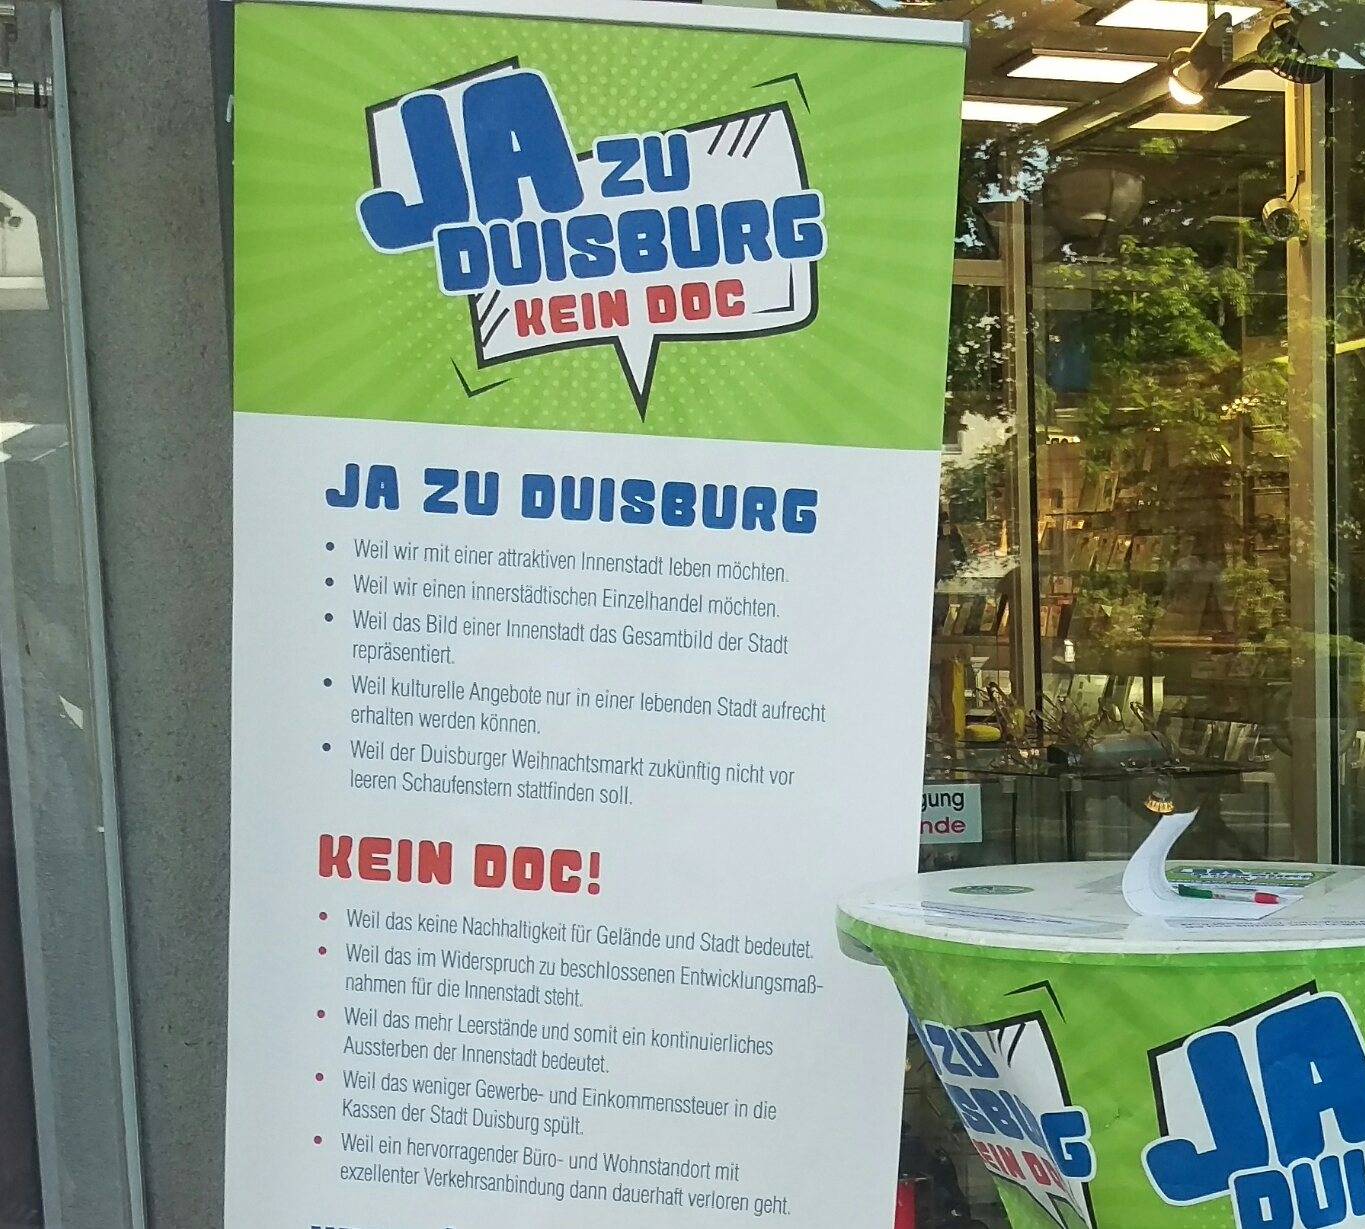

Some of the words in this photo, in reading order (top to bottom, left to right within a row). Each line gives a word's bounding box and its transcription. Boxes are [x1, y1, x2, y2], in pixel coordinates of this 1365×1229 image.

[361, 71, 584, 250] JA
[597, 134, 690, 198] ZU
[441, 194, 822, 291] DUISBURG
[514, 286, 630, 338] KEIN
[647, 279, 746, 325] DOC
[326, 463, 400, 511] JA
[423, 468, 500, 516] ZU
[522, 473, 818, 535] DUISBURG
[355, 539, 388, 559] Weil
[394, 542, 419, 560] wir
[424, 544, 449, 563] mit
[455, 545, 493, 565] einer
[498, 548, 575, 569] attraktiven
[582, 551, 663, 575] Innenstadt
[669, 557, 711, 578] leben
[717, 561, 789, 582] möchten.
[354, 574, 387, 594] Weil
[393, 577, 418, 596] wir
[423, 579, 465, 599] einen
[472, 581, 596, 607] innerstädtischen
[603, 589, 702, 613] Einzelhandel
[708, 596, 779, 617] möchten.
[353, 610, 386, 630] Weil
[393, 612, 421, 634] das
[426, 614, 458, 637] Bild
[463, 617, 501, 637] einer
[507, 619, 585, 642] Innenstadt
[590, 624, 616, 643] das
[623, 625, 712, 649] Gesamtbild
[718, 632, 743, 651] der
[748, 633, 788, 654] Stadt
[353, 642, 454, 664] repräsentiert.
[351, 705, 413, 726] erhalten
[419, 711, 475, 730] werden
[481, 712, 540, 734] können.
[353, 675, 385, 696] Weil
[392, 677, 464, 700] kulturelle
[469, 682, 541, 706] Angebote
[547, 691, 571, 706] nur
[576, 688, 590, 707] in
[595, 690, 635, 711] einer
[640, 693, 711, 715] lebenden
[717, 697, 757, 718] Stadt
[762, 701, 826, 722] aufrecht
[351, 740, 383, 760] Weil
[390, 743, 416, 761] der
[421, 744, 507, 770] Duisburger
[513, 749, 644, 776] Weihnachtsmarkt
[649, 759, 720, 785] zukünftig
[726, 763, 765, 783] nicht
[769, 770, 795, 785] vor
[351, 769, 396, 789] leeren
[402, 772, 512, 799] Schaufenstern
[517, 781, 594, 802] stattfinden
[600, 786, 632, 805] soll.
[318, 834, 453, 886] KEIN
[474, 843, 601, 895] DOC!
[347, 909, 379, 928] Weil
[386, 912, 412, 931] das
[418, 914, 457, 935] keine
[463, 916, 566, 943] Nachhaltigkeit
[571, 924, 592, 943] für
[597, 924, 660, 948] Gelände
[666, 932, 695, 950] und
[700, 932, 740, 953] Stadt
[745, 935, 813, 959] bedeutet.
[346, 974, 406, 994] nahmen
[411, 977, 432, 995] für
[437, 979, 459, 997] die
[465, 980, 540, 1004] Innenstadt
[544, 987, 583, 1007] steht.
[347, 943, 378, 963] Weil
[385, 946, 411, 967] das
[417, 948, 436, 967] im
[442, 949, 534, 975] Widerspruch
[539, 961, 555, 975] zu
[561, 958, 674, 984] beschlossenen
[681, 966, 823, 995] Entwicklungsmaß-
[343, 1036, 428, 1063] Aussterben
[434, 1042, 457, 1061] der
[462, 1044, 537, 1068] Innenstadt
[542, 1050, 609, 1073] bedeutet.
[345, 1007, 377, 1026] Weil
[383, 1010, 409, 1029] das
[415, 1013, 453, 1031] mehr
[458, 1014, 537, 1038] Leerstände
[542, 1023, 569, 1041] und
[574, 1025, 617, 1044] somit
[623, 1027, 645, 1046] ein
[652, 1028, 773, 1055] kontinuierliches
[925, 1024, 999, 1078] ZU
[343, 1099, 396, 1120] Kassen
[402, 1103, 426, 1122] der
[430, 1104, 468, 1127] Stadt
[473, 1108, 539, 1135] Duisburg
[544, 1116, 583, 1137] spült.
[344, 1070, 375, 1090] Weil
[381, 1073, 407, 1092] das
[413, 1077, 471, 1099] weniger
[476, 1079, 544, 1102] Gewerbe-
[550, 1087, 577, 1105] und
[583, 1088, 729, 1116] Einkommenssteuer
[735, 1099, 748, 1117] in
[753, 1101, 776, 1120] die
[342, 1133, 373, 1152] Weil
[379, 1136, 401, 1155] ein
[407, 1137, 519, 1164] hervorragender
[523, 1147, 563, 1167] Büro-
[569, 1153, 598, 1170] und
[603, 1153, 710, 1179] Wohnstandort
[715, 1162, 739, 1181] mit
[341, 1164, 420, 1184] exzellenter
[425, 1168, 564, 1201] Verkehrsanbindung
[570, 1180, 607, 1200] dann
[613, 1183, 684, 1206] dauerhaft
[688, 1191, 748, 1211] verloren
[754, 1196, 790, 1216] geht.
